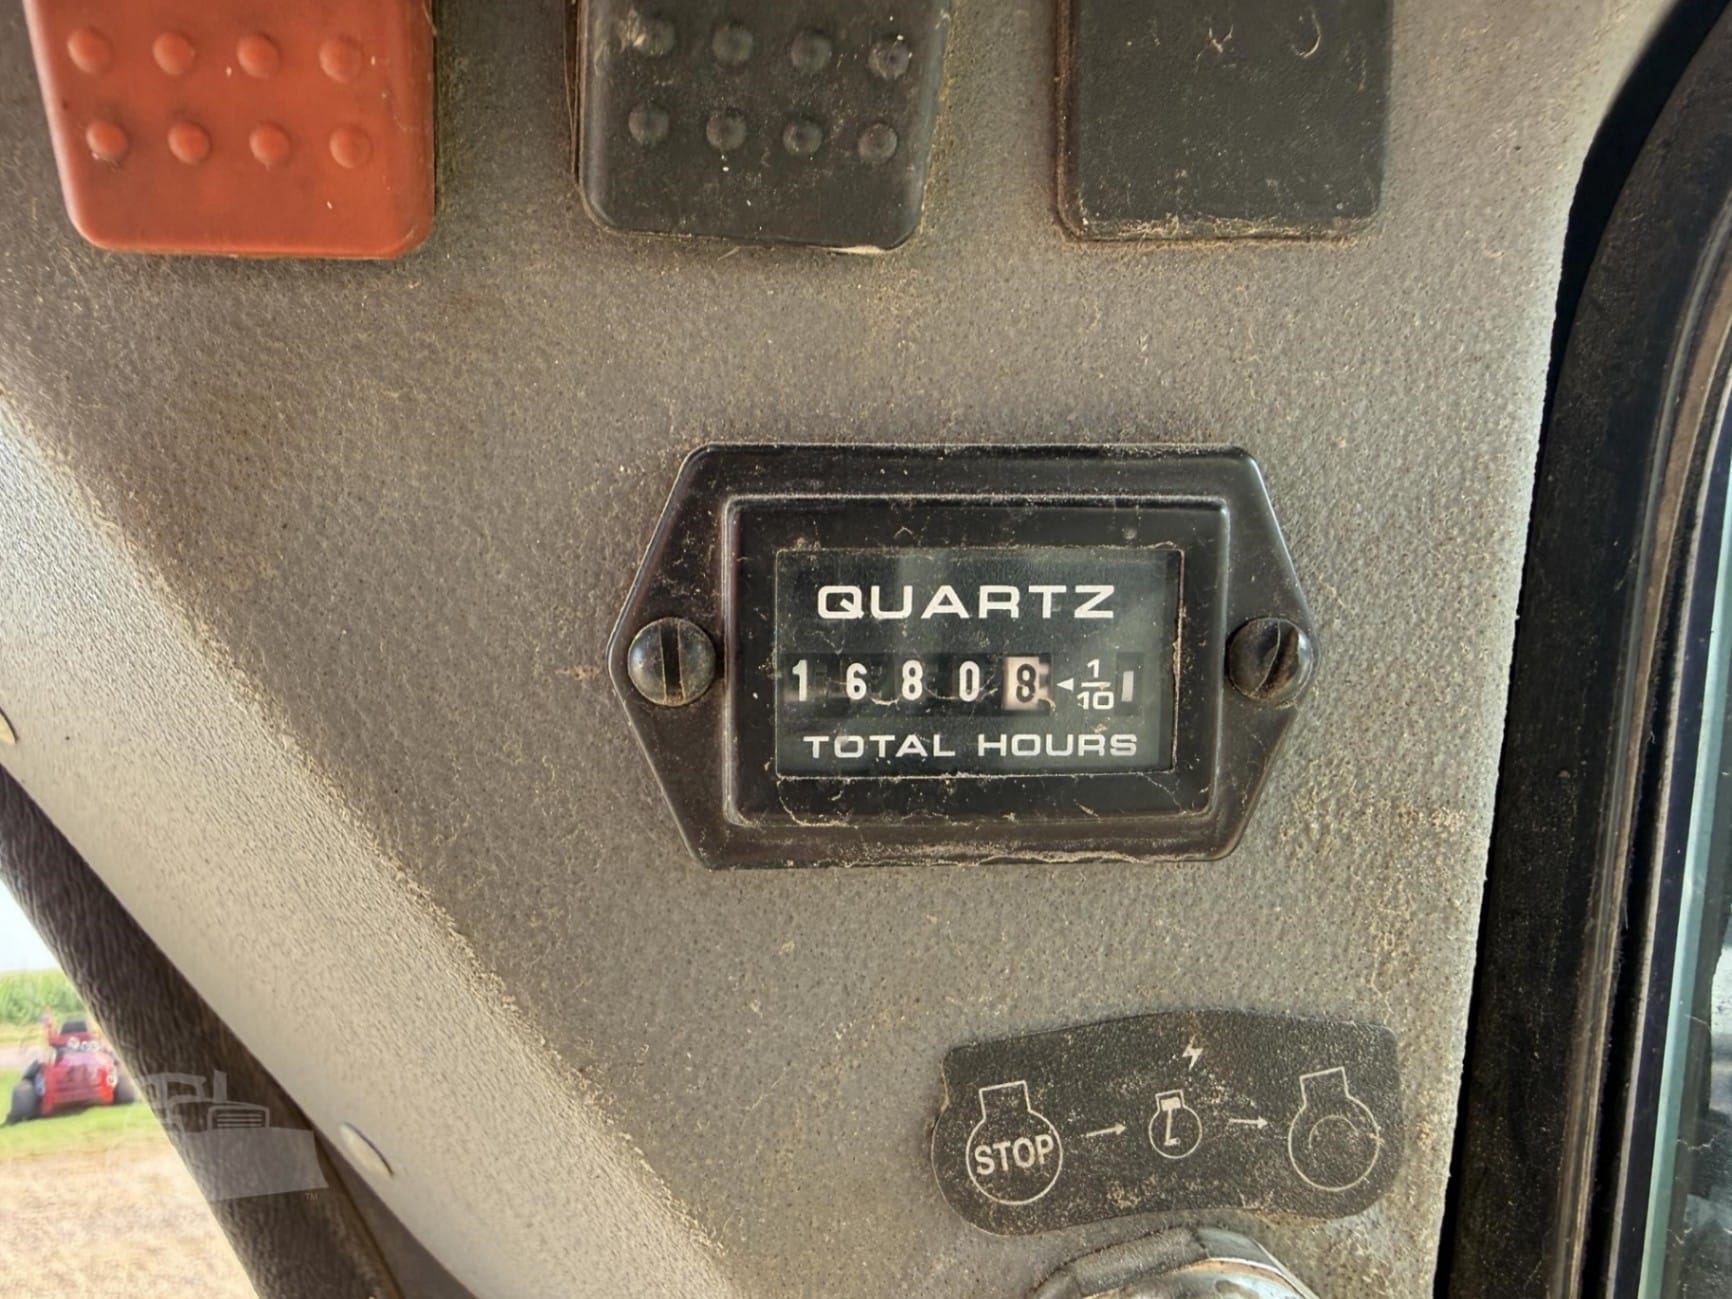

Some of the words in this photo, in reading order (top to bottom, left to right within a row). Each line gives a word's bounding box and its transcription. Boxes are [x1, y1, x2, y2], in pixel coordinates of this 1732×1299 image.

[817, 585, 1115, 620] QUARTZ
[803, 734, 956, 759] TOTAL
[977, 733, 1138, 757] HOURS
[974, 1134, 1054, 1176] STOP
